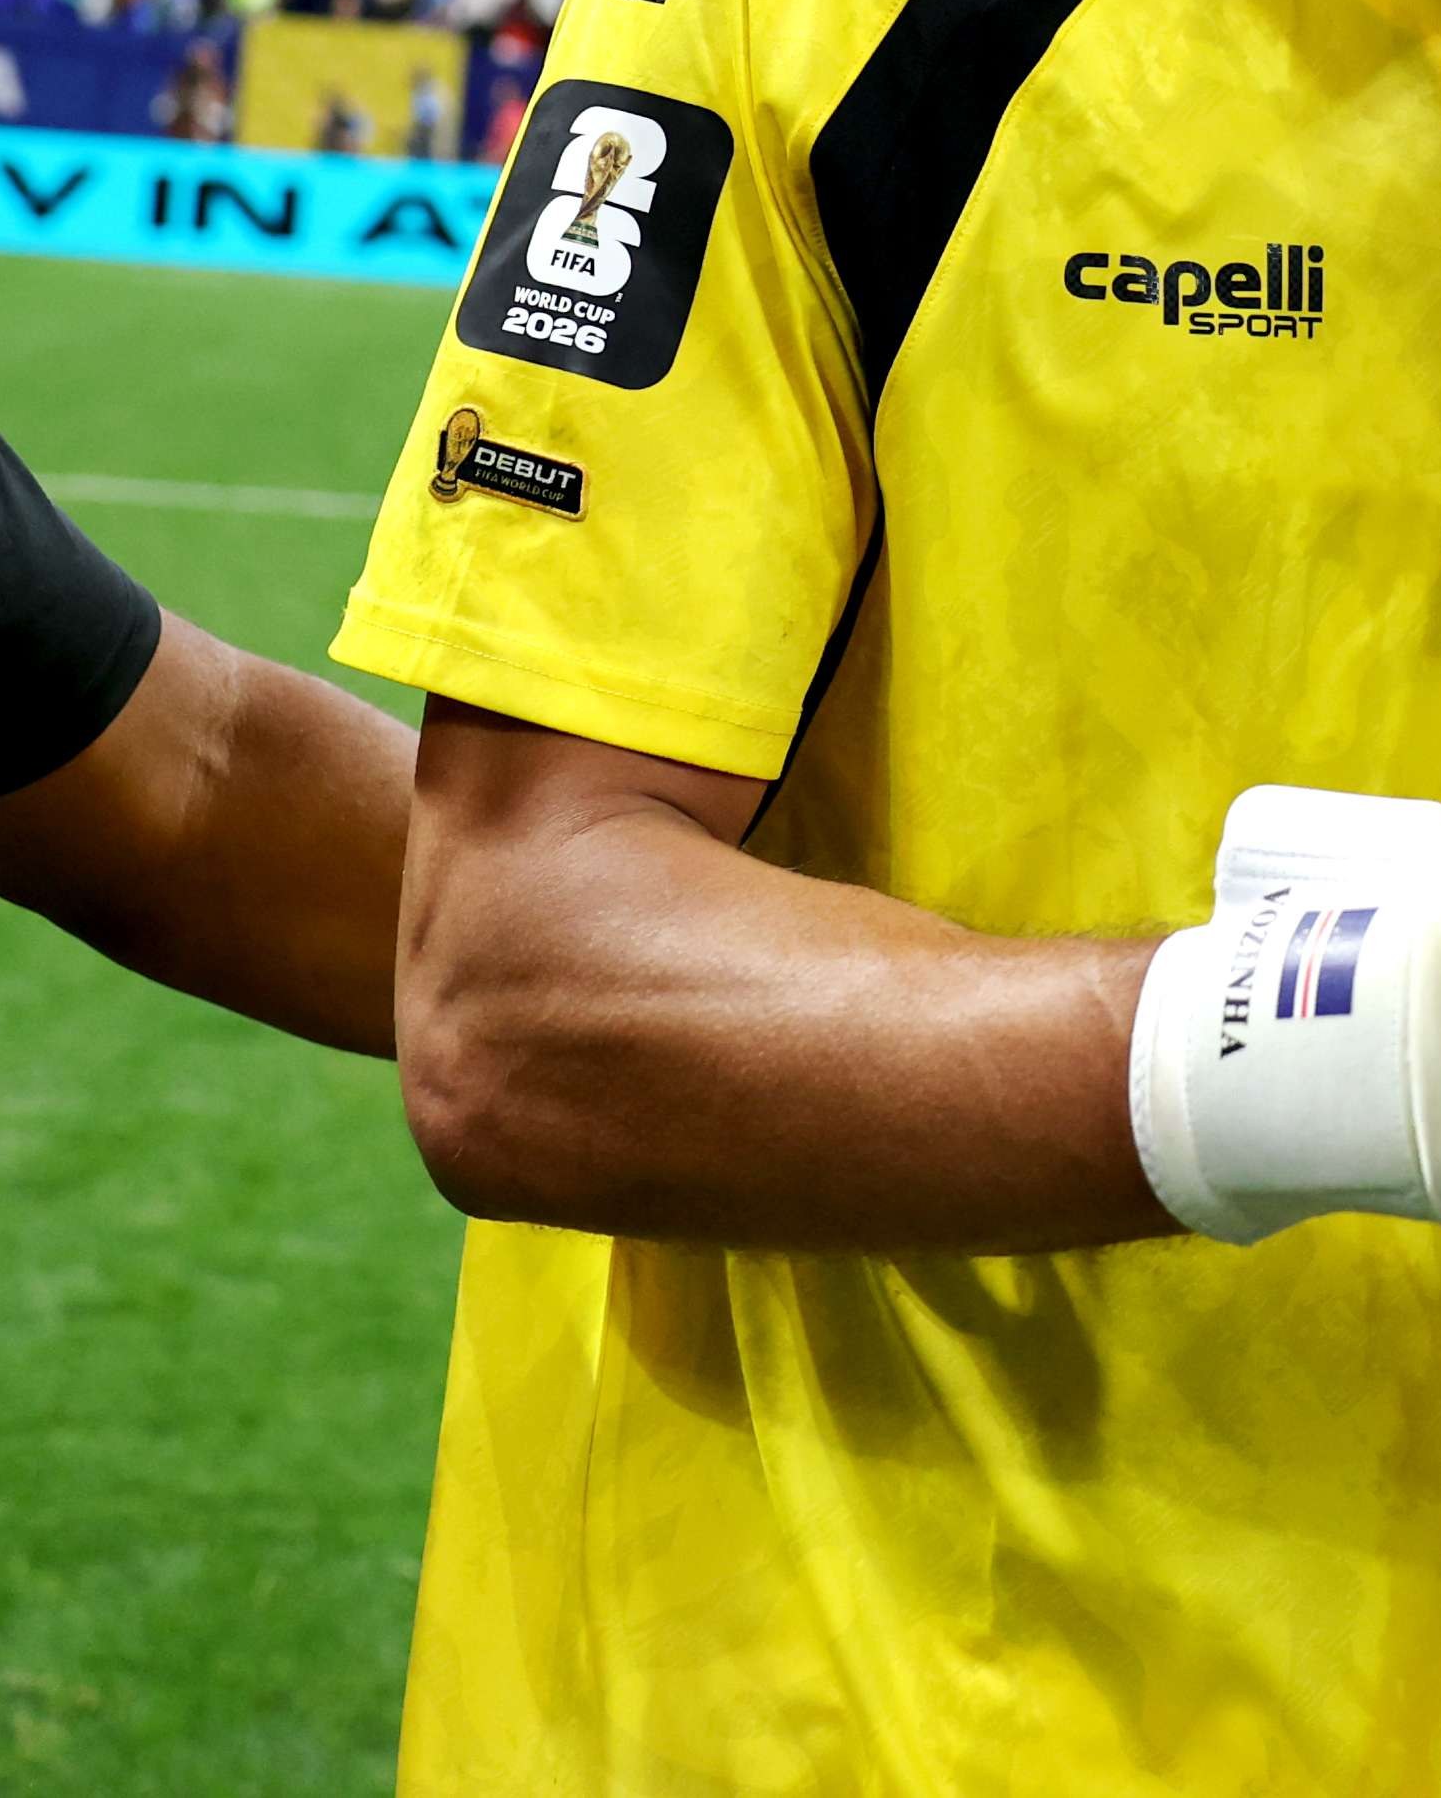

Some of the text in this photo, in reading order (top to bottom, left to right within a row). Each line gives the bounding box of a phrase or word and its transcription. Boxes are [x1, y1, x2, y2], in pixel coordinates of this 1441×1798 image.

[151, 175, 299, 239] IN
[362, 193, 491, 249] A
[550, 249, 595, 276] FIFA
[1063, 243, 1324, 325] capelli
[514, 286, 616, 325] WORLD CUP
[1189, 312, 1323, 339] SPORT
[502, 307, 607, 354] 2026
[474, 446, 576, 489] DEBUT
[475, 468, 565, 502] FIFA WORLD CUP
